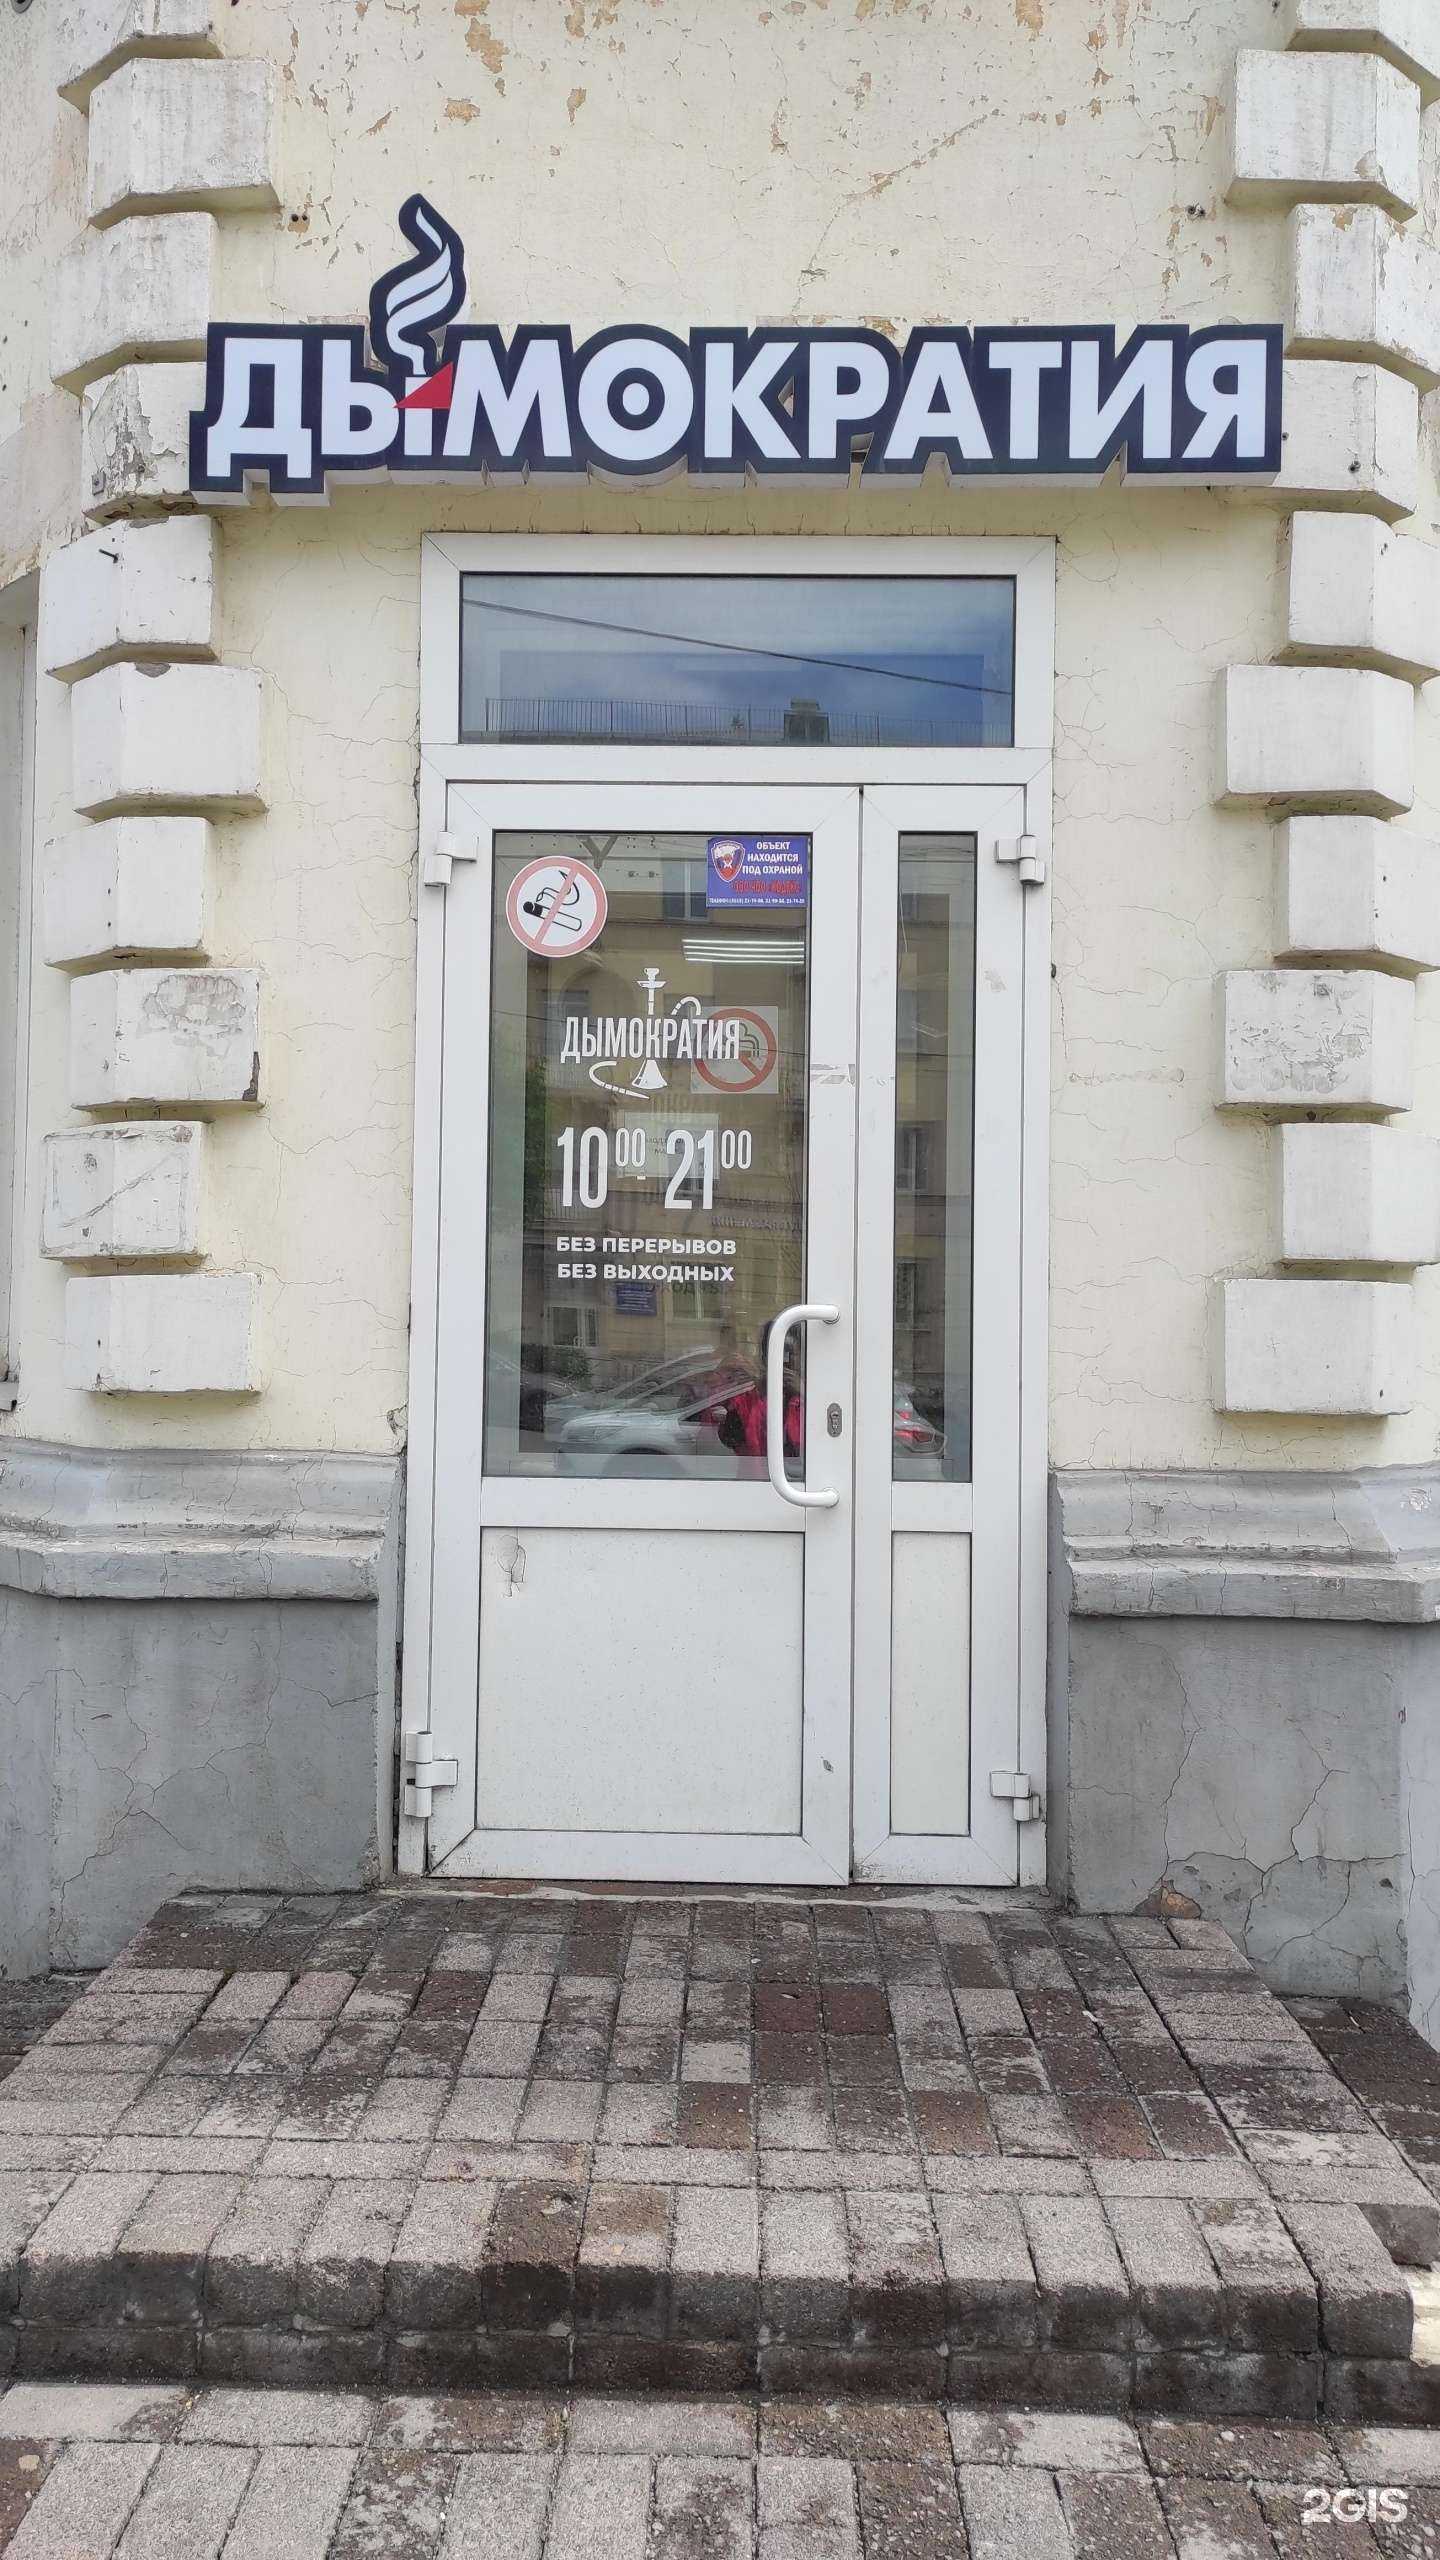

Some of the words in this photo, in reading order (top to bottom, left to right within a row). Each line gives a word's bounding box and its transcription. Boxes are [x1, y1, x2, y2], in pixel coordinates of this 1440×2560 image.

[206, 335, 1267, 481] ДЫМОКРАТИЯ
[756, 841, 791, 850] ОБЪЕКТ
[747, 853, 799, 863] НАХОДИТСЯ
[742, 865, 761, 875] ПОД
[762, 864, 803, 875] ОХРАНОЙ
[560, 1016, 741, 1064] ДЫМОКРАТИЯ
[556, 1236, 596, 1253] БЕЗ
[602, 1238, 737, 1255] ПЕРЕРЫВОВ
[557, 1264, 597, 1280] БЕЗ
[603, 1265, 735, 1282] ВЫХОДНЫХ
